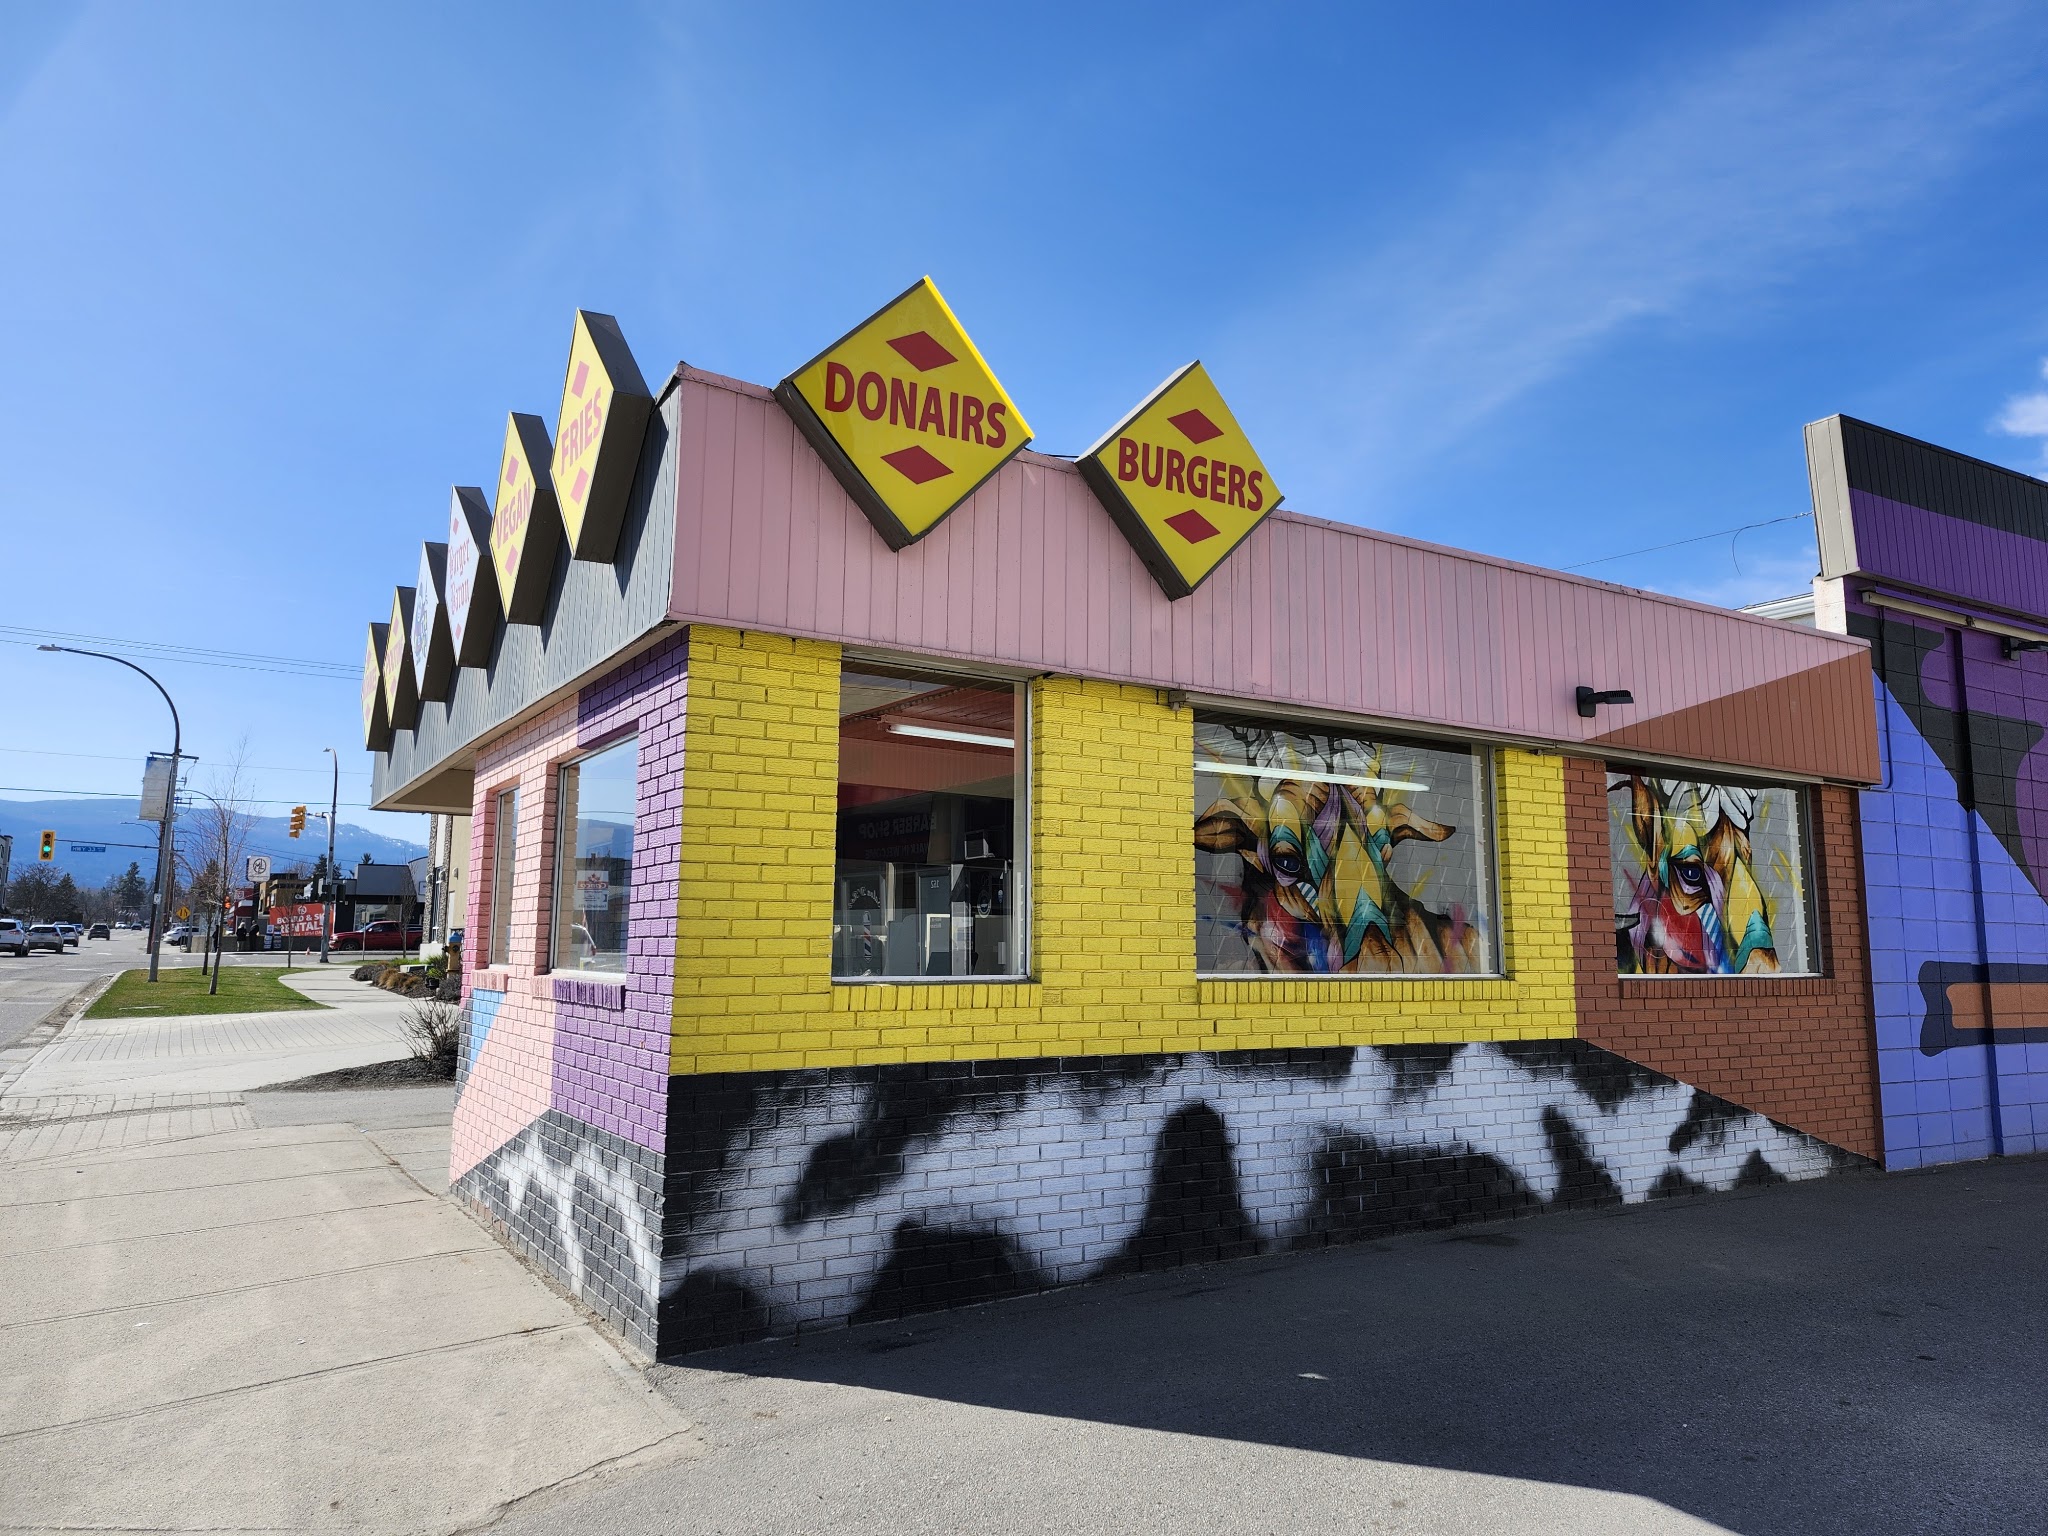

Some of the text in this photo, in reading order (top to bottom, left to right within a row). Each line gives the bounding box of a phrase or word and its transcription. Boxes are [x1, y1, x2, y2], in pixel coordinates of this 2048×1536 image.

[561, 386, 602, 477] FRIES
[824, 361, 1007, 448] DONAIRS
[1117, 437, 1263, 511] BURGERS
[495, 477, 531, 550] VEGAN
[448, 538, 470, 580] Burger
[450, 579, 470, 616] Baron
